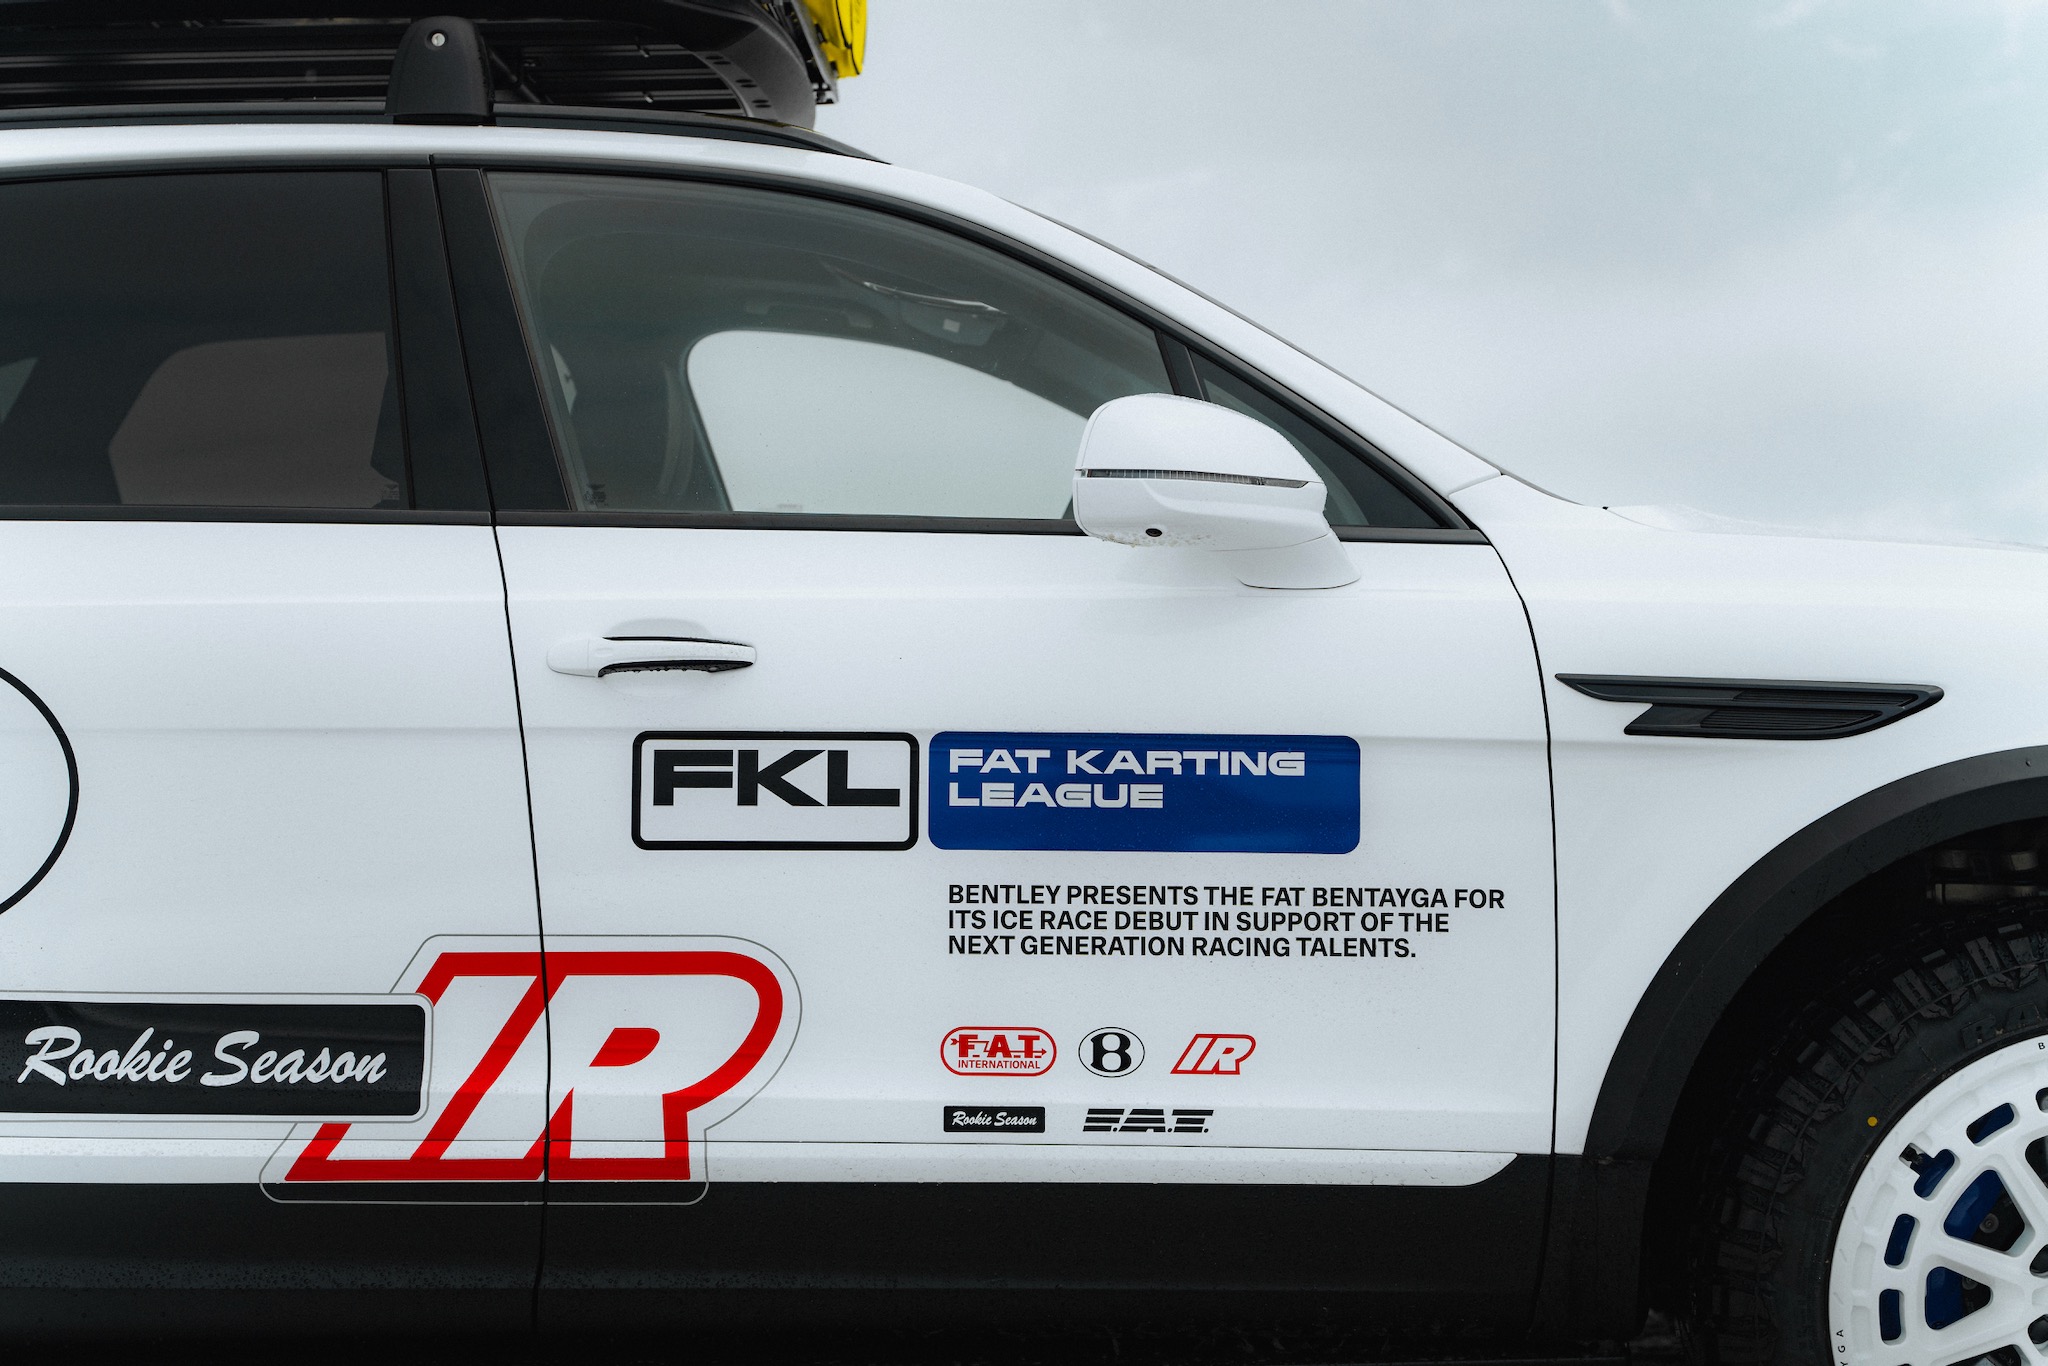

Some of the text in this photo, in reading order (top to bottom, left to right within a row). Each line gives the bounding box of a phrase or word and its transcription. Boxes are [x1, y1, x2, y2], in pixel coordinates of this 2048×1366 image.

[950, 749, 1305, 776] FAT KARTING
[653, 750, 900, 806] FKL
[949, 783, 1163, 808] LEAGUE
[949, 885, 1504, 908] BENTLEY PRESENTS THE FAT BENTAYGA FOR
[949, 910, 1448, 932] ITS ICE RACE DEBUT IN SUPPORT OF THE
[949, 936, 1415, 957] NEXT GENERATION RACING TALENTS.
[17, 1026, 386, 1086] Rookie Season
[958, 1060, 1040, 1069] INTERNATIONAL
[952, 1111, 1037, 1126] Rookie Season
